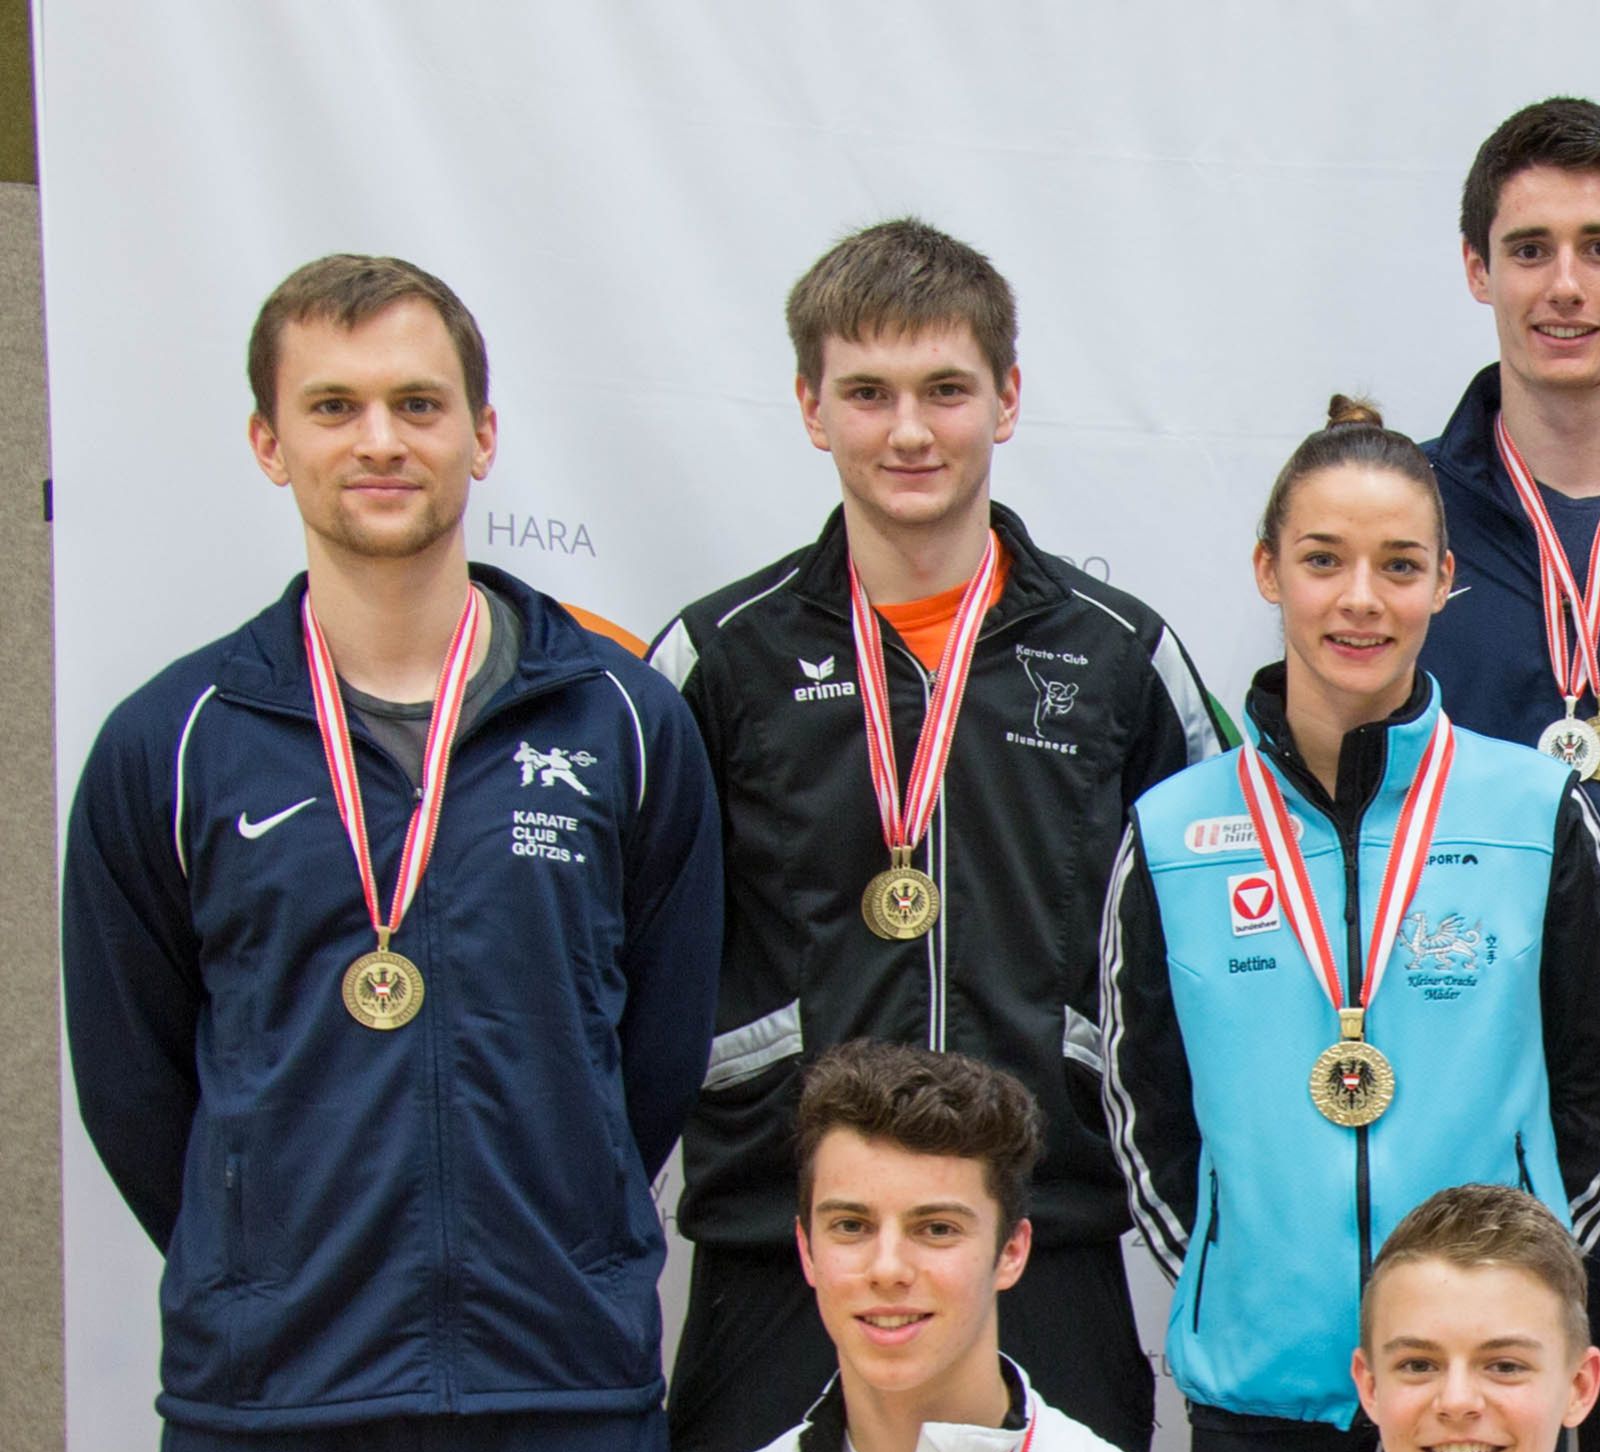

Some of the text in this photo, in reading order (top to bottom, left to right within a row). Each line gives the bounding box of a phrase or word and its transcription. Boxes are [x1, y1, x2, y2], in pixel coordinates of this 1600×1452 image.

[487, 511, 596, 557] HARA
[795, 679, 855, 702] erima
[513, 810, 578, 831] KARATE
[512, 826, 557, 843] CLUB
[511, 839, 571, 862] GÖTZIS
[1426, 854, 1461, 865] PORT
[1228, 956, 1277, 974] Bettina
